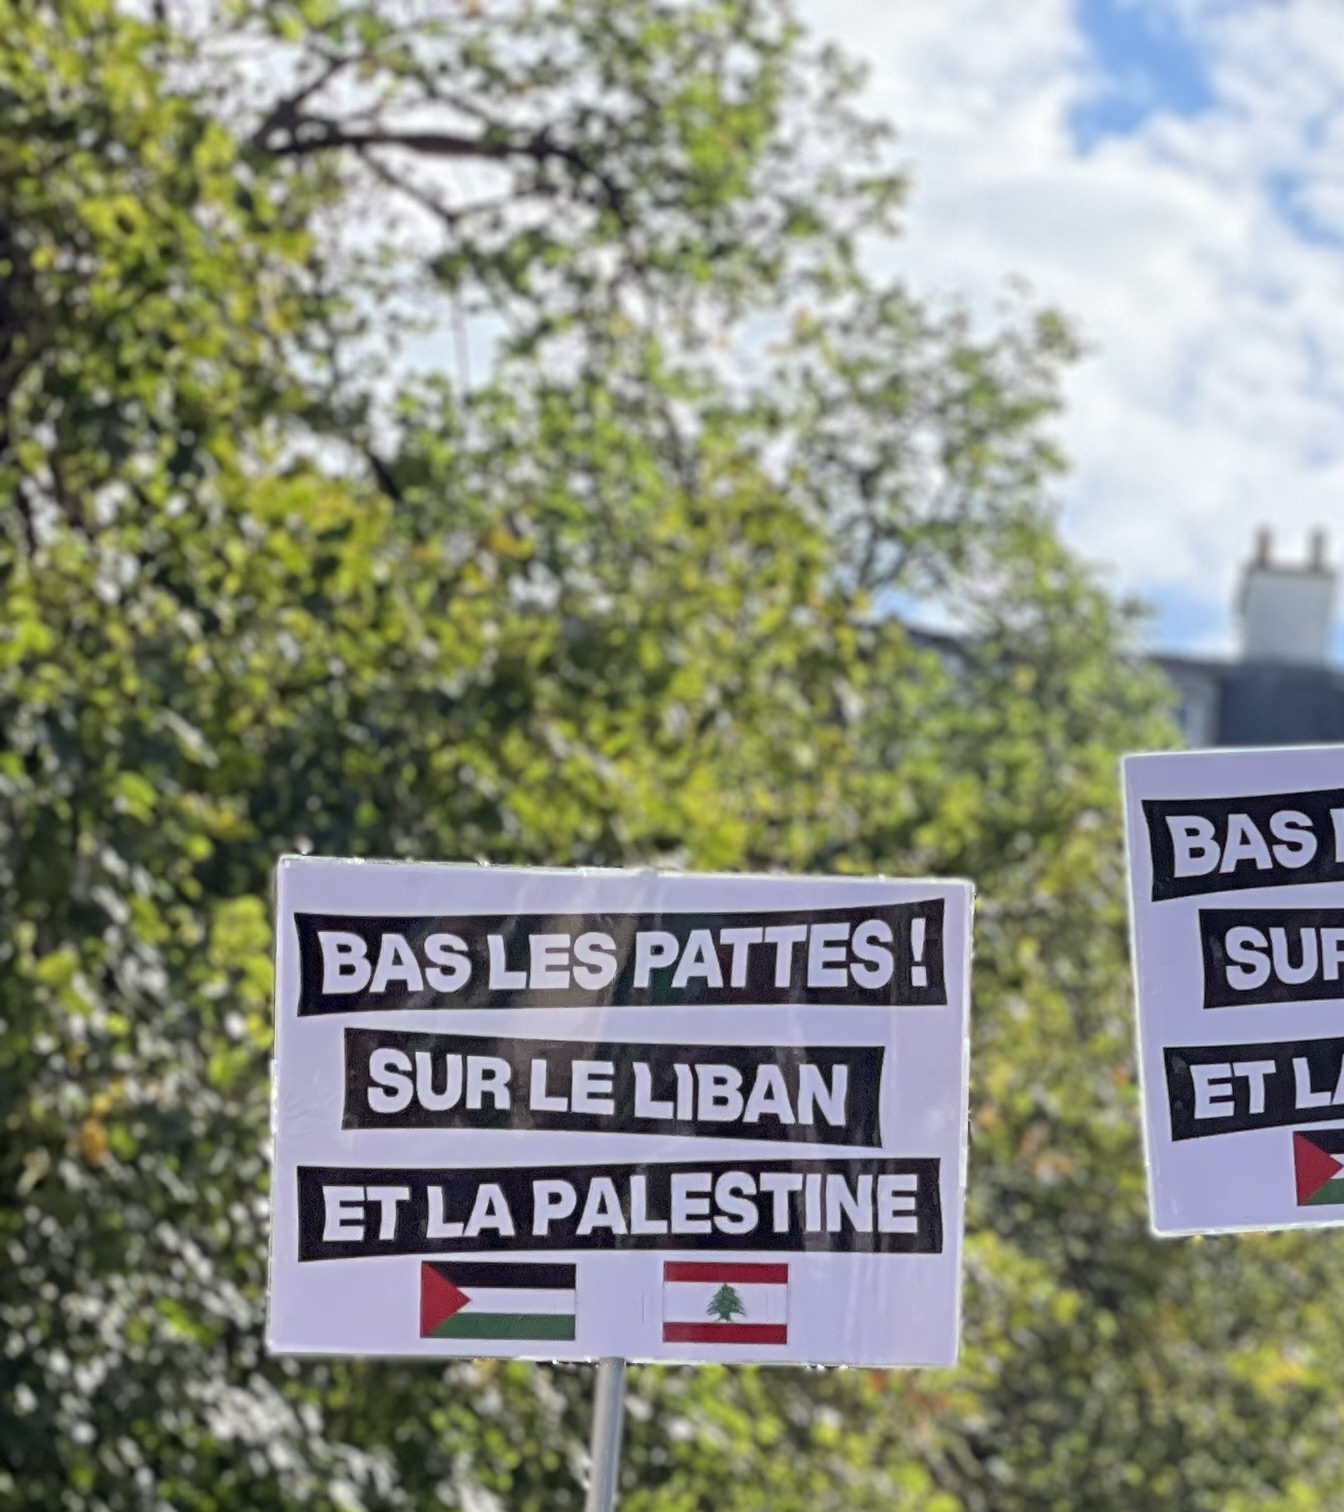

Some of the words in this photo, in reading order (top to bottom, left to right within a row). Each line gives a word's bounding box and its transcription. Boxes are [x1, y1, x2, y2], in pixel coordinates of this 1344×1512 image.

[1165, 810, 1318, 878] BAS
[317, 931, 472, 995] BAS
[486, 931, 619, 991] LES
[633, 919, 895, 990] PATTES
[367, 1047, 512, 1114] SUR
[529, 1057, 616, 1116] LE
[632, 1061, 849, 1127] LIBAN
[1189, 1059, 1277, 1120] ET
[322, 1185, 411, 1242] ET
[425, 1183, 516, 1239] LA
[532, 1170, 919, 1236] PALESTINE
